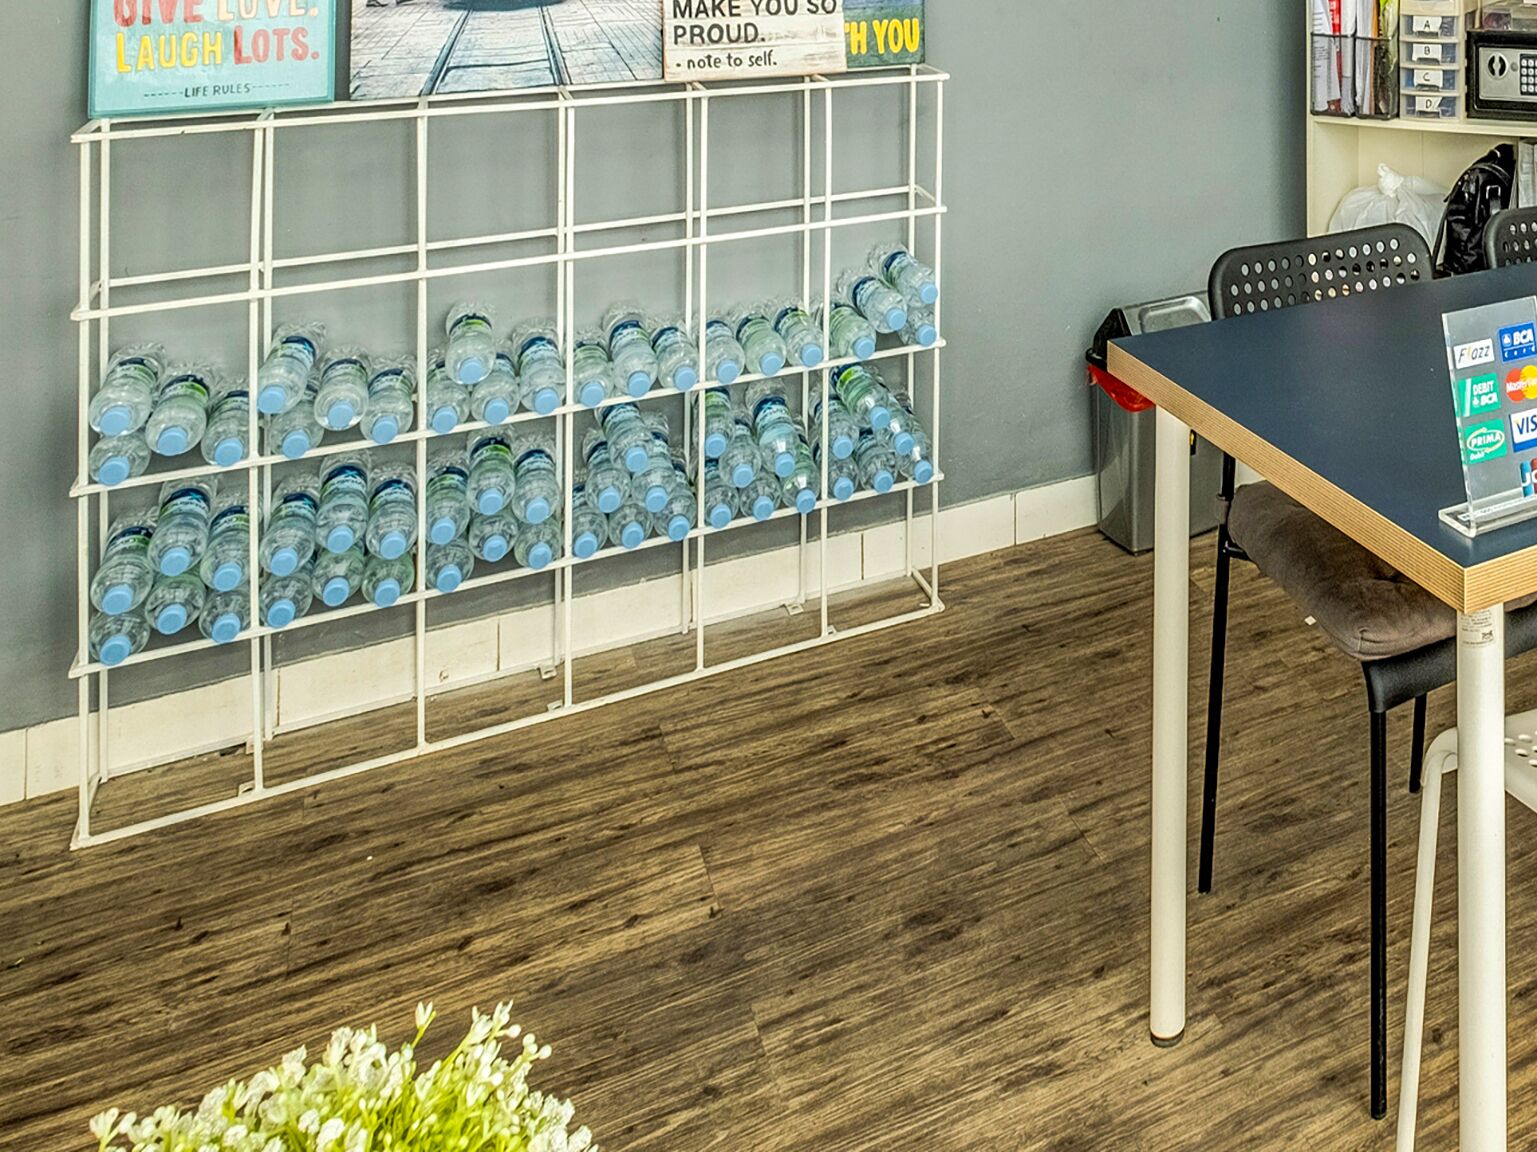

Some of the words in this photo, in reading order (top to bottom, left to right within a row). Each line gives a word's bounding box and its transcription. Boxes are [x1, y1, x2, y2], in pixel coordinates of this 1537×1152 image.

[1423, 19, 1431, 30] A
[673, 22, 766, 46] PROUD.
[872, 17, 920, 54] YOU
[116, 31, 223, 73] LAUGH
[233, 25, 320, 65] LOTS.
[1423, 45, 1431, 56] B
[687, 54, 722, 69] note
[726, 52, 743, 68] to
[748, 49, 778, 67] self.
[1422, 72, 1431, 82] C
[184, 85, 209, 98] LIFE
[213, 83, 251, 97] RULES
[1425, 98, 1433, 109] D
[1513, 328, 1534, 346] BCA
[1472, 380, 1495, 396] DEBIT
[1480, 392, 1499, 406] BCA
[1471, 432, 1502, 449] PRIMA
